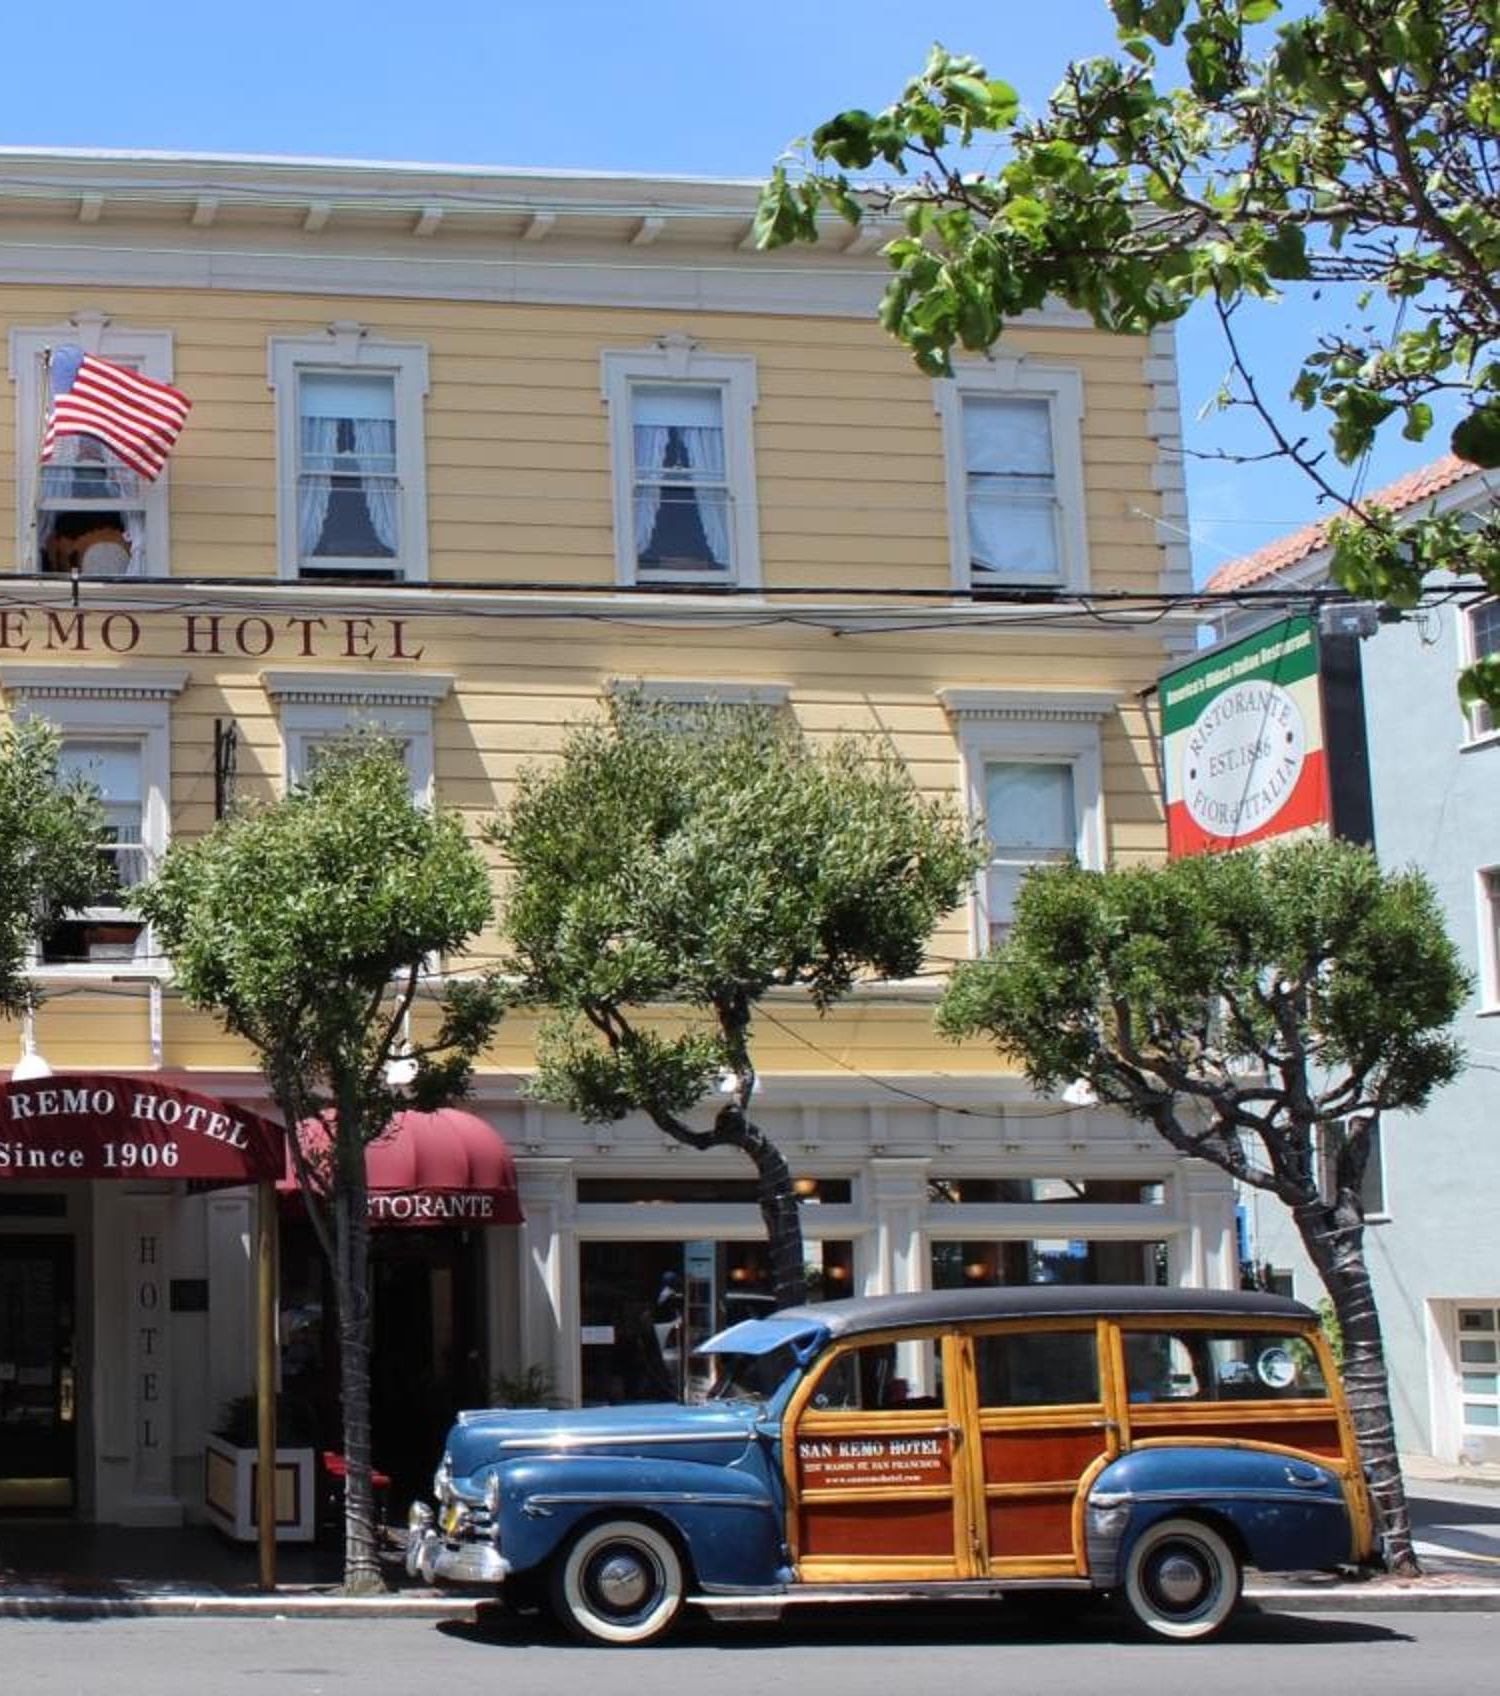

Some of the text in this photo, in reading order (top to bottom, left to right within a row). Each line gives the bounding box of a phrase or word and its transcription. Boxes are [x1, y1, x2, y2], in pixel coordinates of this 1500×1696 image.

[182, 615, 425, 661] HOTEL
[1190, 691, 1291, 757] RISTORANTE
[1194, 790, 1230, 825] FIOR
[8, 1088, 116, 1119] REMO
[132, 1095, 251, 1150] HOTEL
[103, 1142, 180, 1168] 1906
[368, 1194, 494, 1217] TORANTE
[140, 1237, 159, 1448] HOTEL
[800, 1440, 942, 1458] SAN REMO HOTEL
